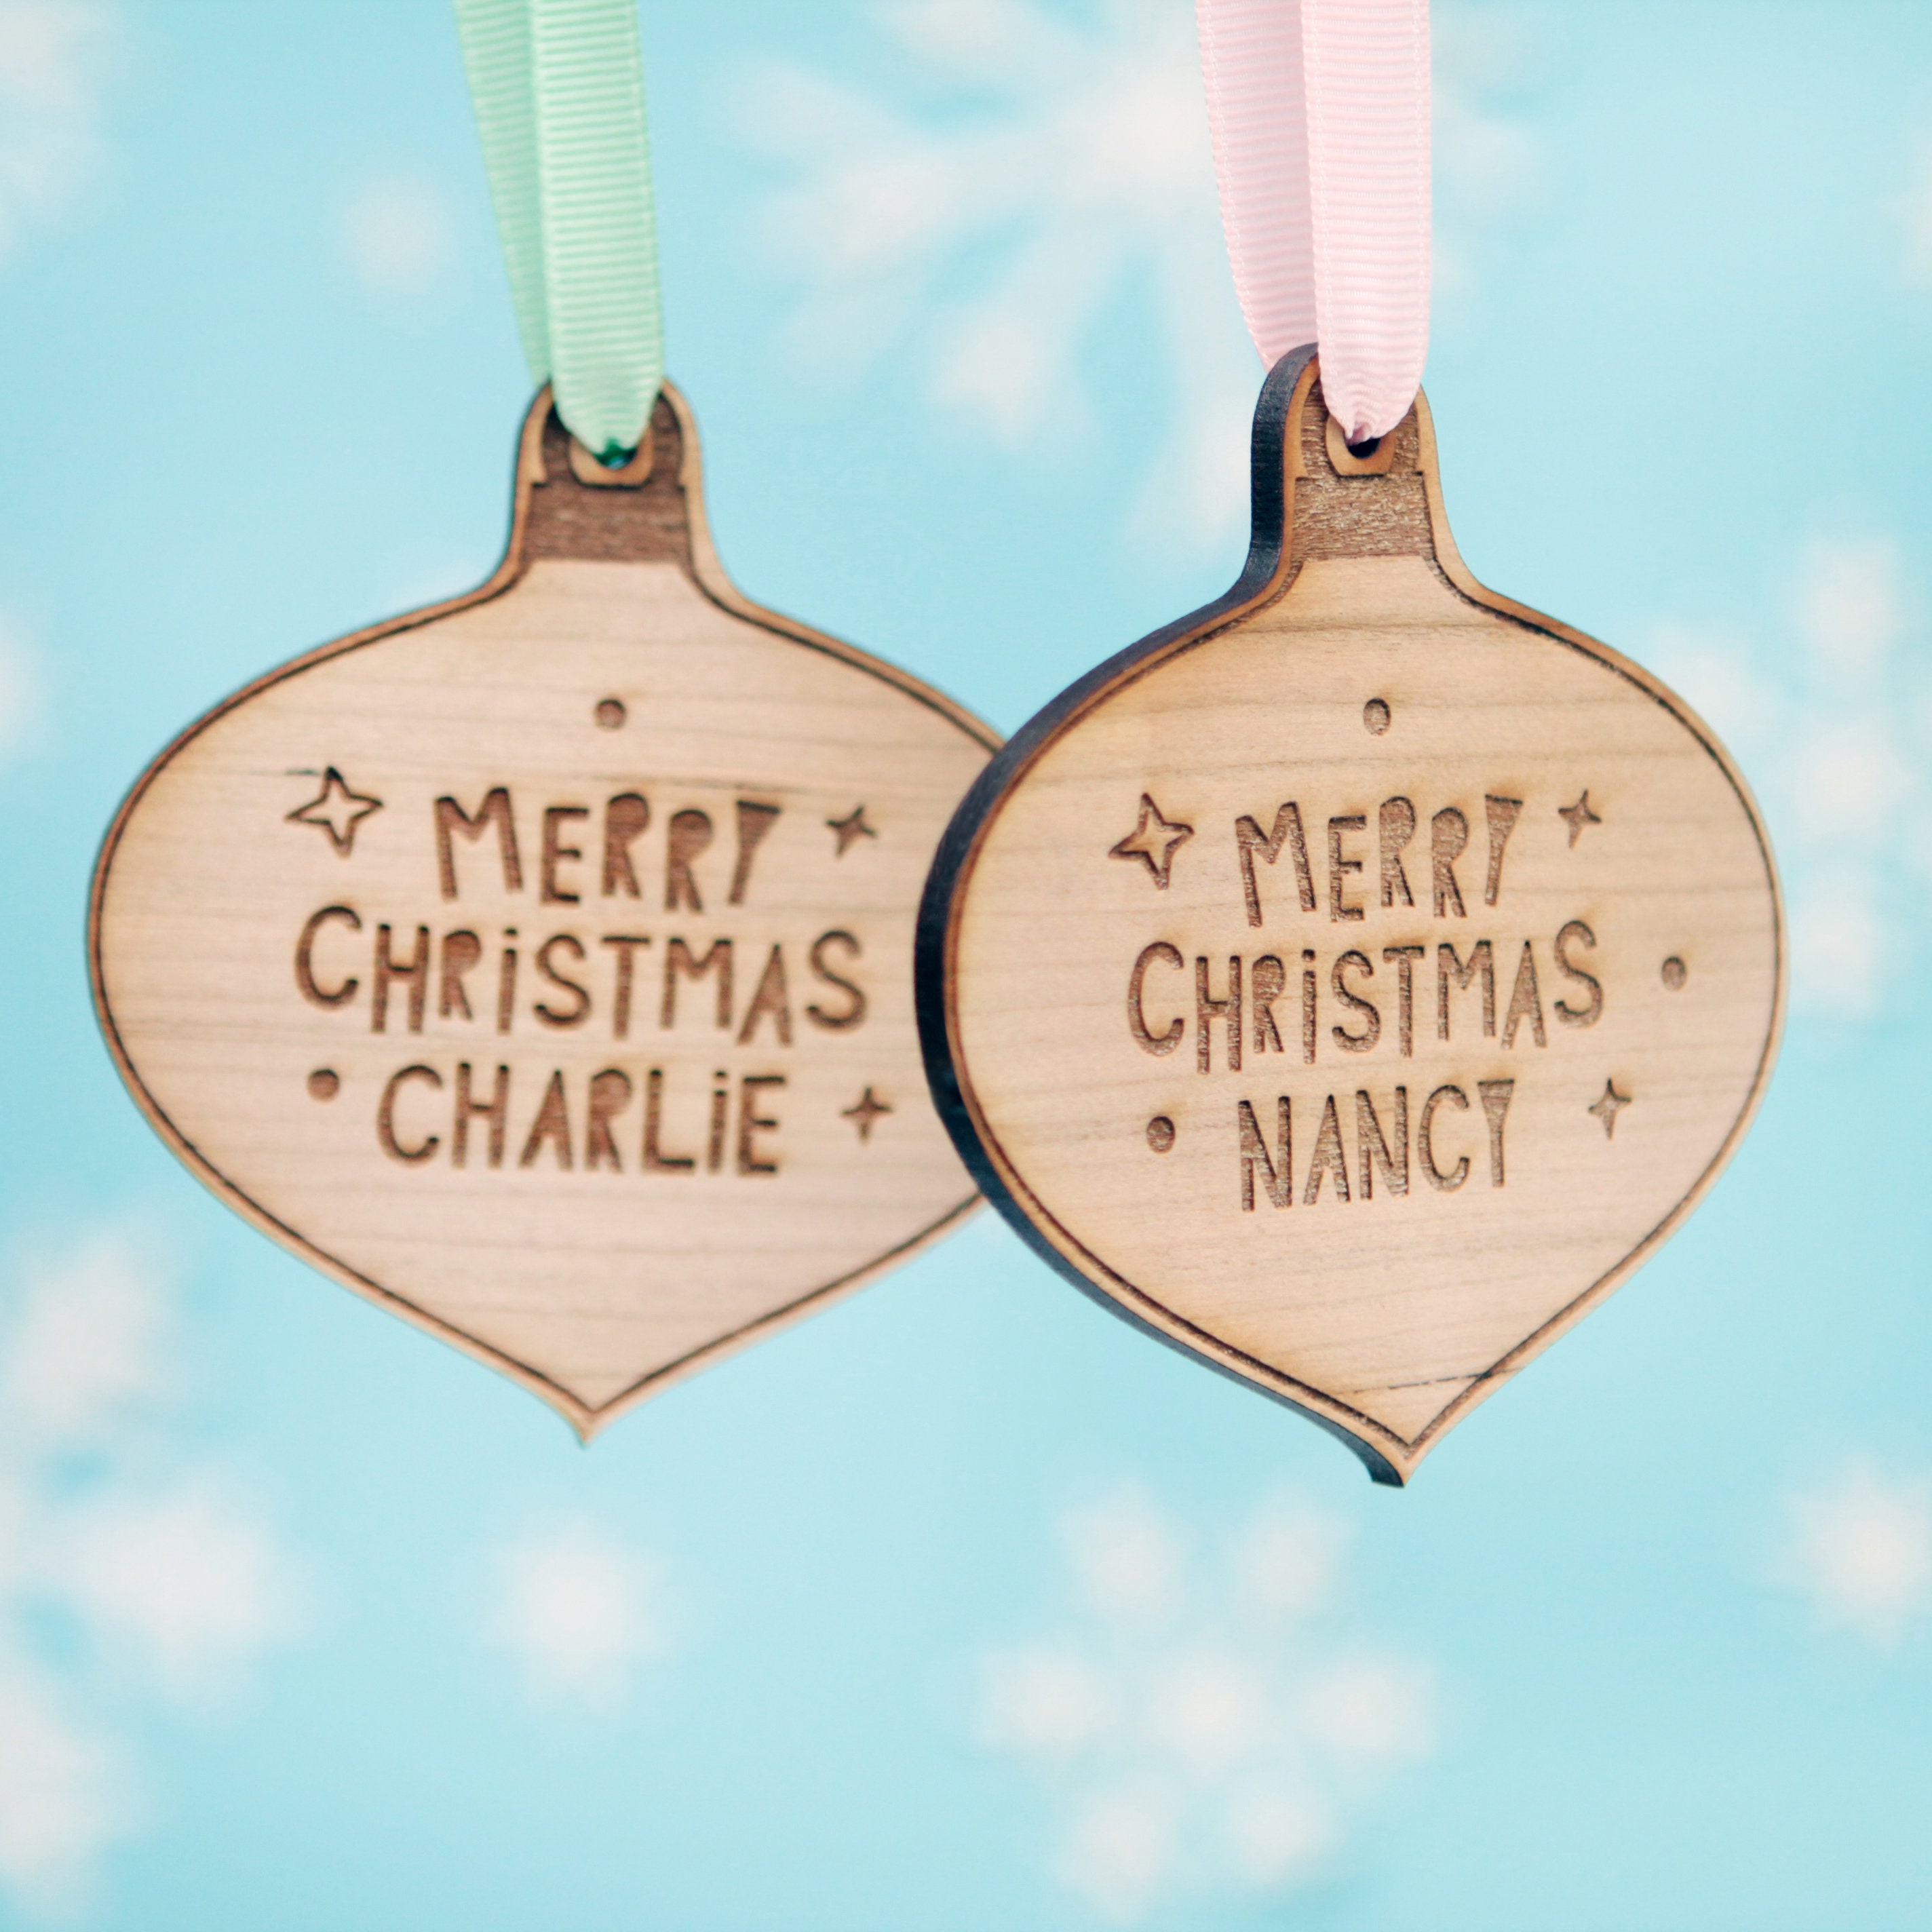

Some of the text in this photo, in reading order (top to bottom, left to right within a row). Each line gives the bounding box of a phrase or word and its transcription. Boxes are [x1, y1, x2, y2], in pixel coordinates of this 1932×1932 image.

[433, 786, 782, 912] MERRY
[1235, 794, 1524, 927] MERRY
[1238, 1079, 1515, 1211] NANCY
